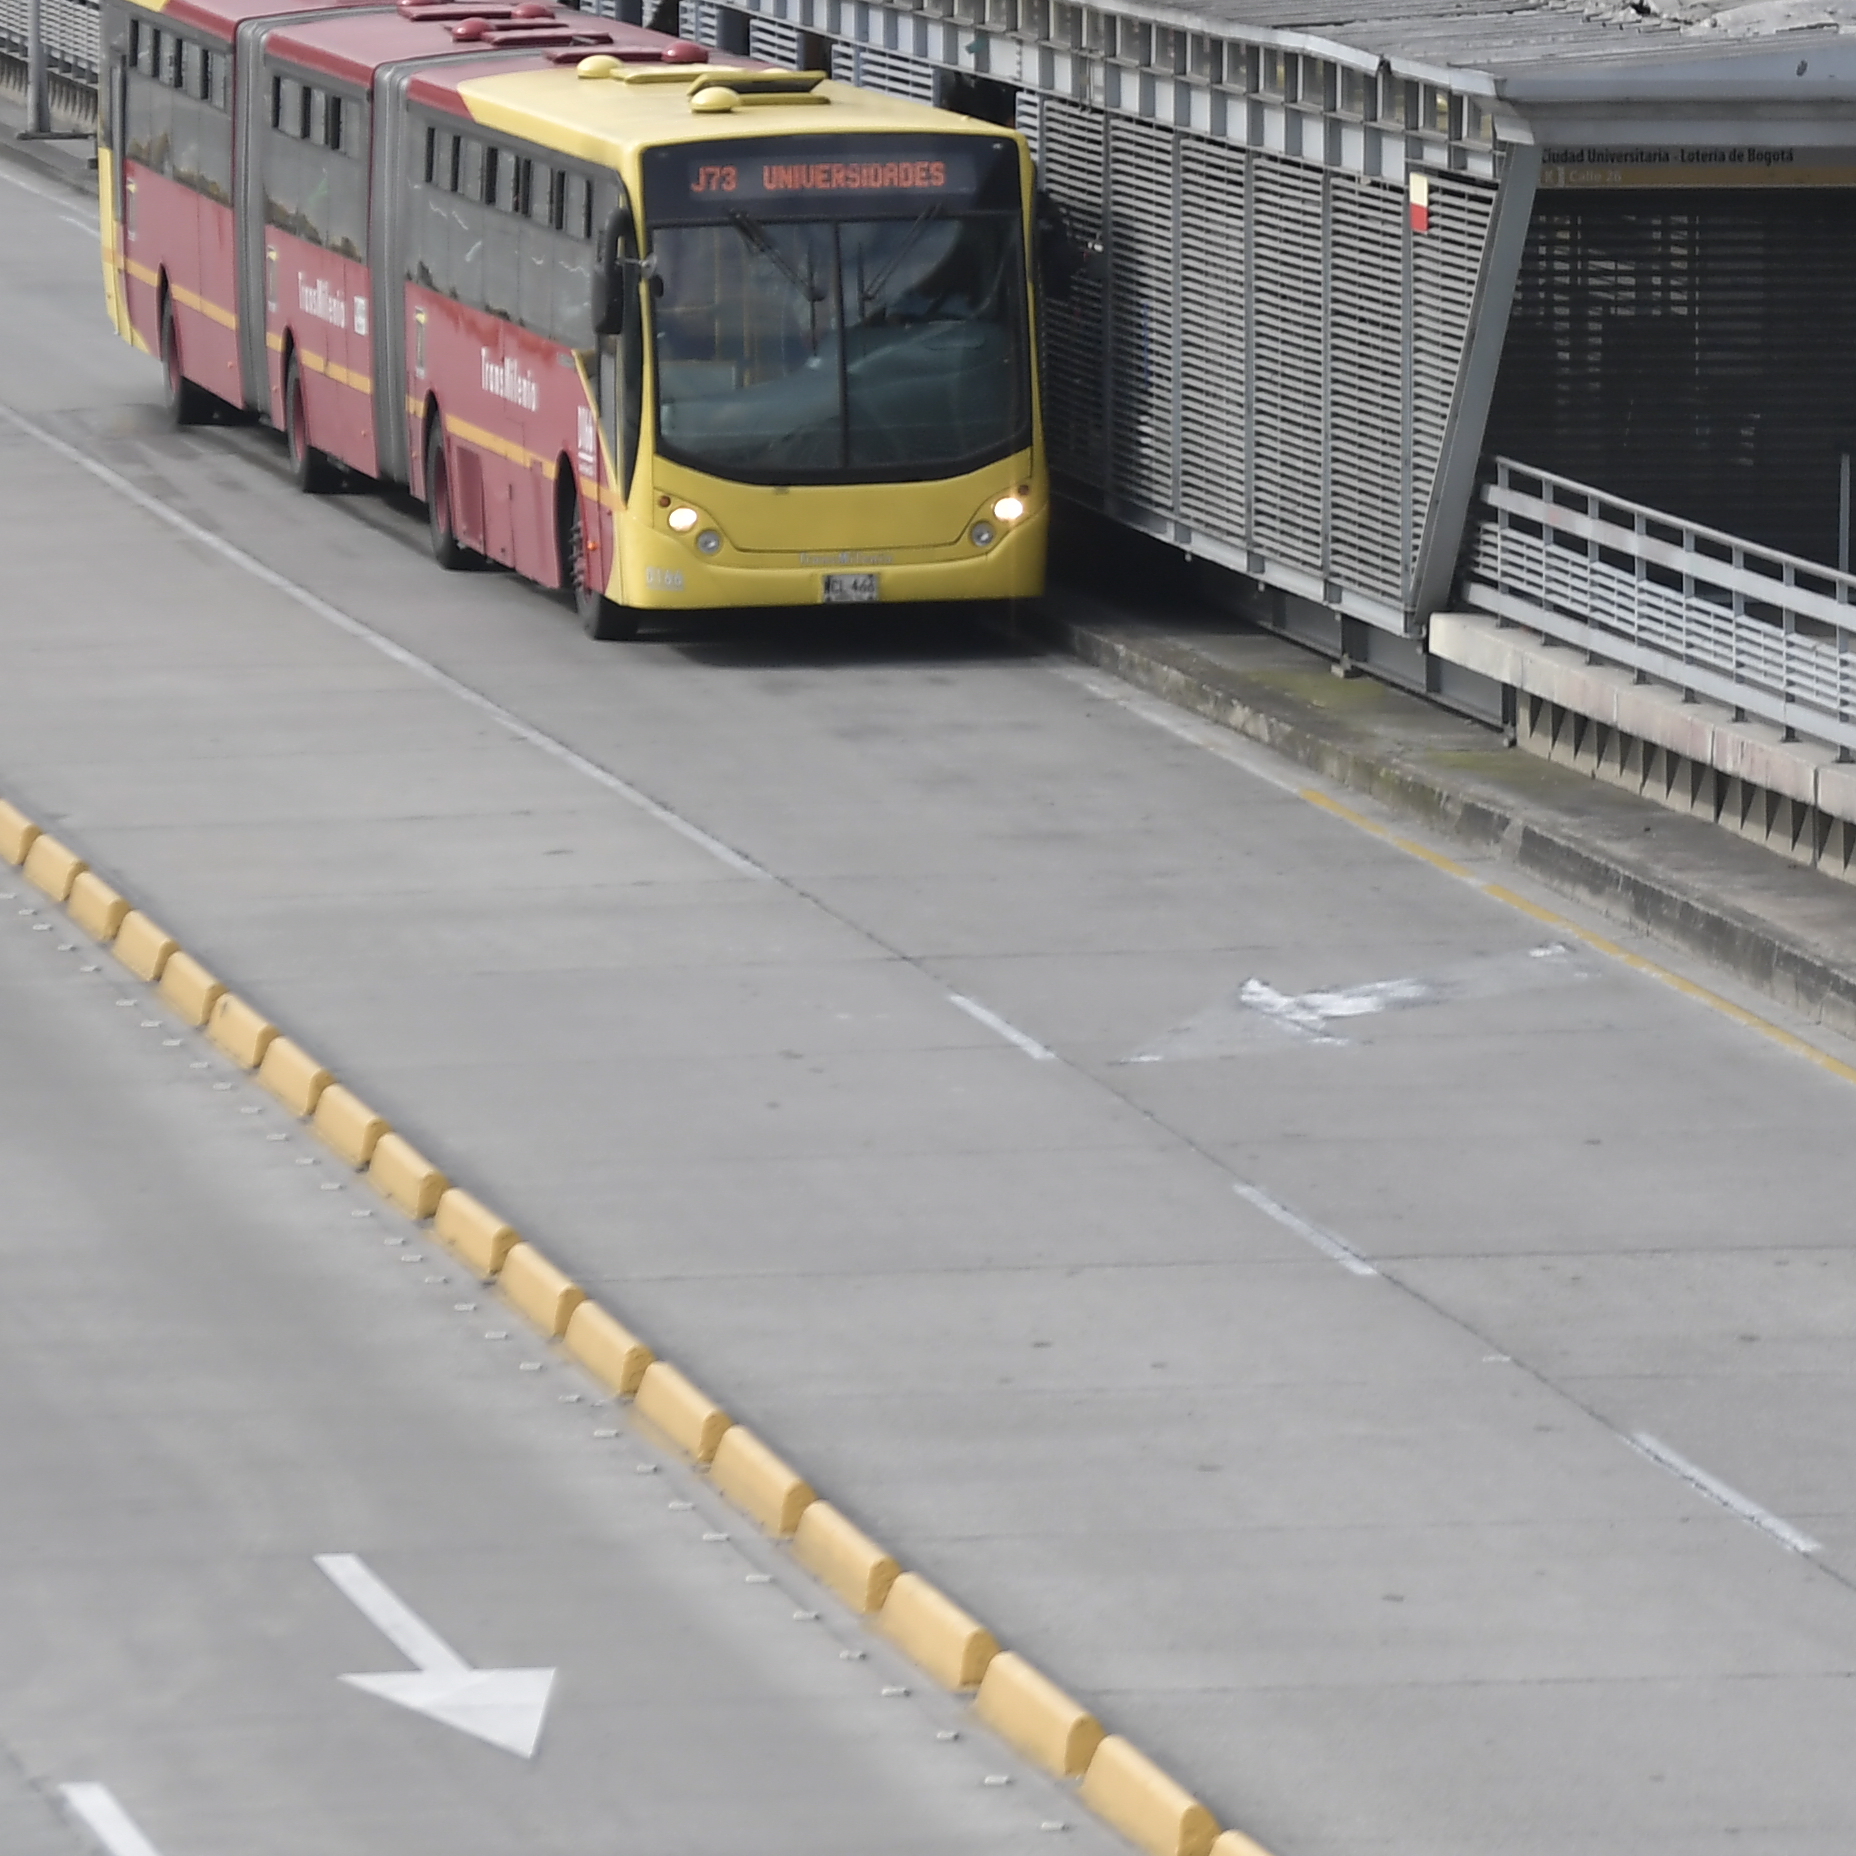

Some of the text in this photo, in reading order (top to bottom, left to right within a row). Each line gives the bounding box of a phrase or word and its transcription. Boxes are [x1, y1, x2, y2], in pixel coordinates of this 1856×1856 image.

[691, 161, 946, 192] J73 UNIVERSIDADES
[1587, 147, 1670, 164] Universitaria
[1680, 147, 1726, 164] Lotería
[1728, 147, 1743, 163] de
[1747, 147, 1794, 167] Bogotá
[298, 271, 346, 329] TransMilenio
[480, 345, 538, 412] TransMilenio
